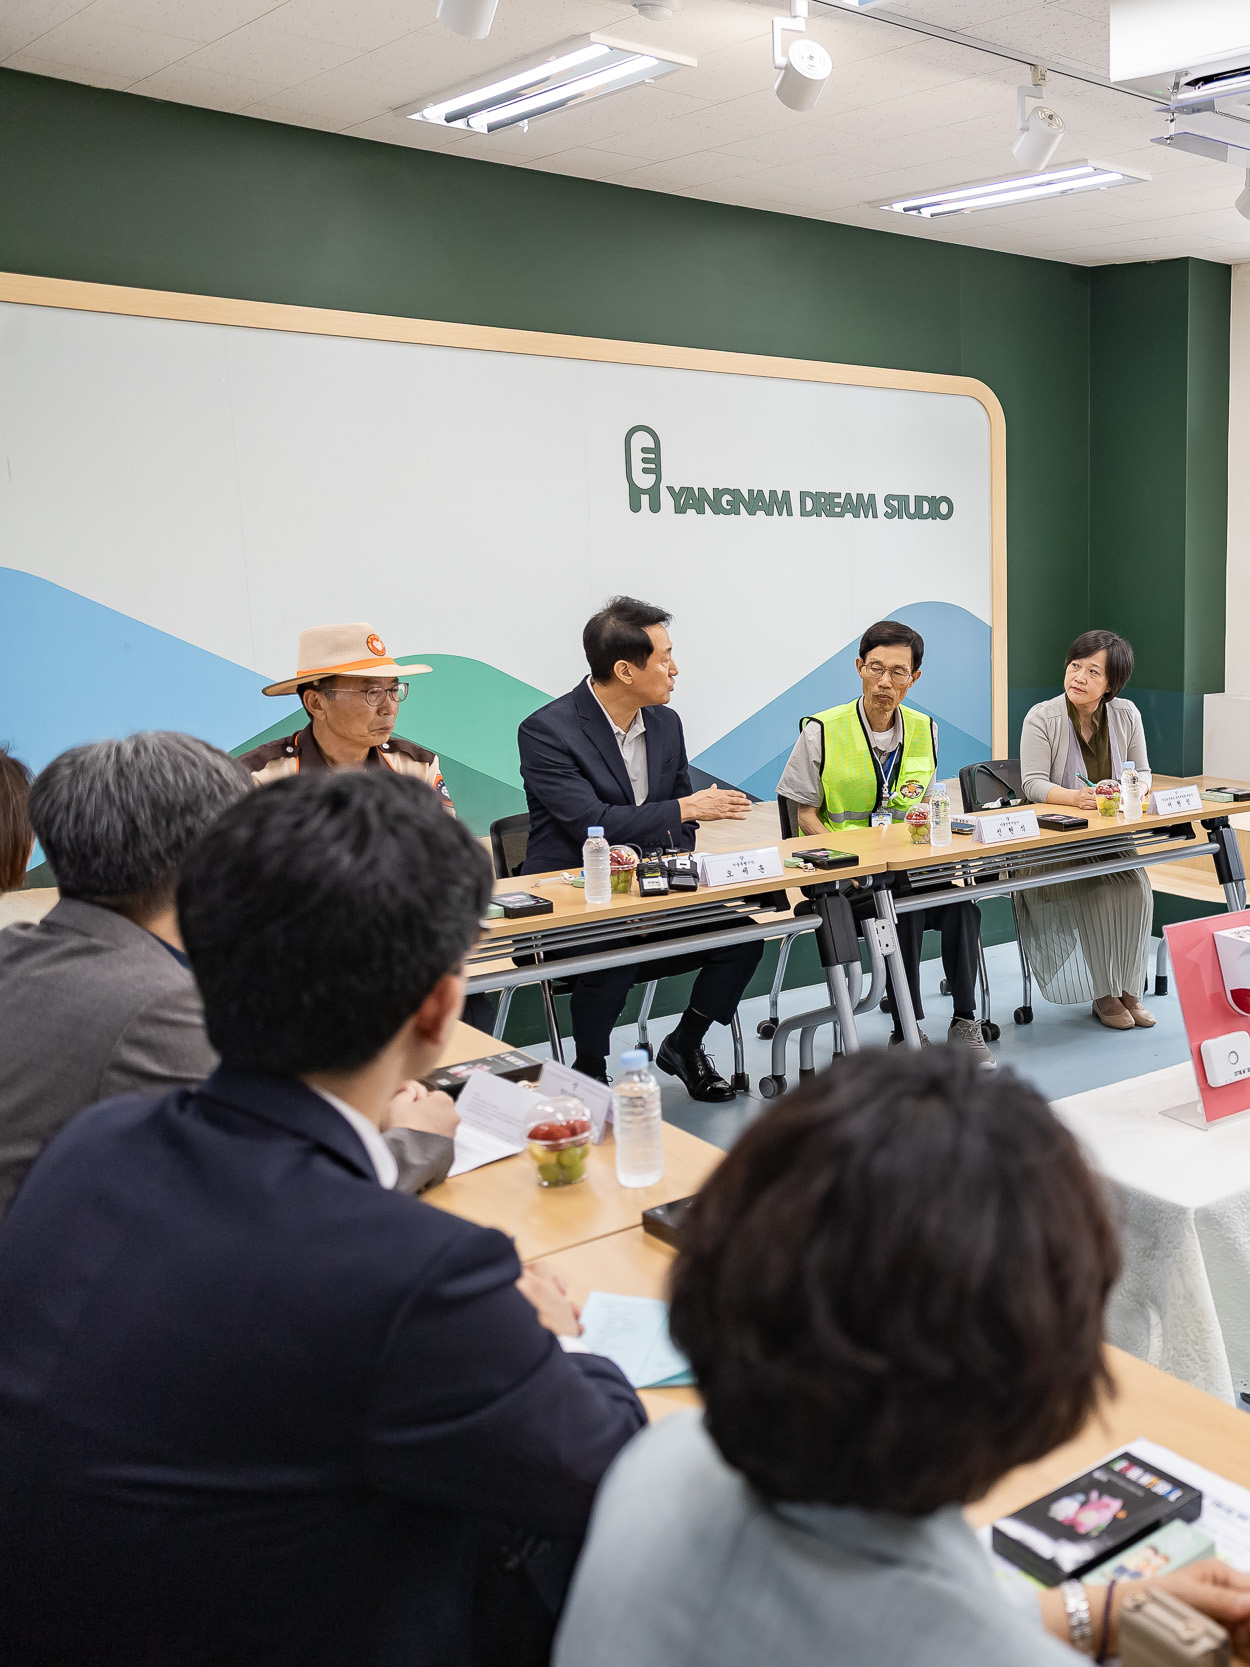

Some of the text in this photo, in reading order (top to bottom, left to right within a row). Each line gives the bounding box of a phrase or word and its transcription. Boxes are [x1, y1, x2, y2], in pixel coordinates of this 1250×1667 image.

[666, 485, 954, 520] YANGNAM DREAM STUDIO
